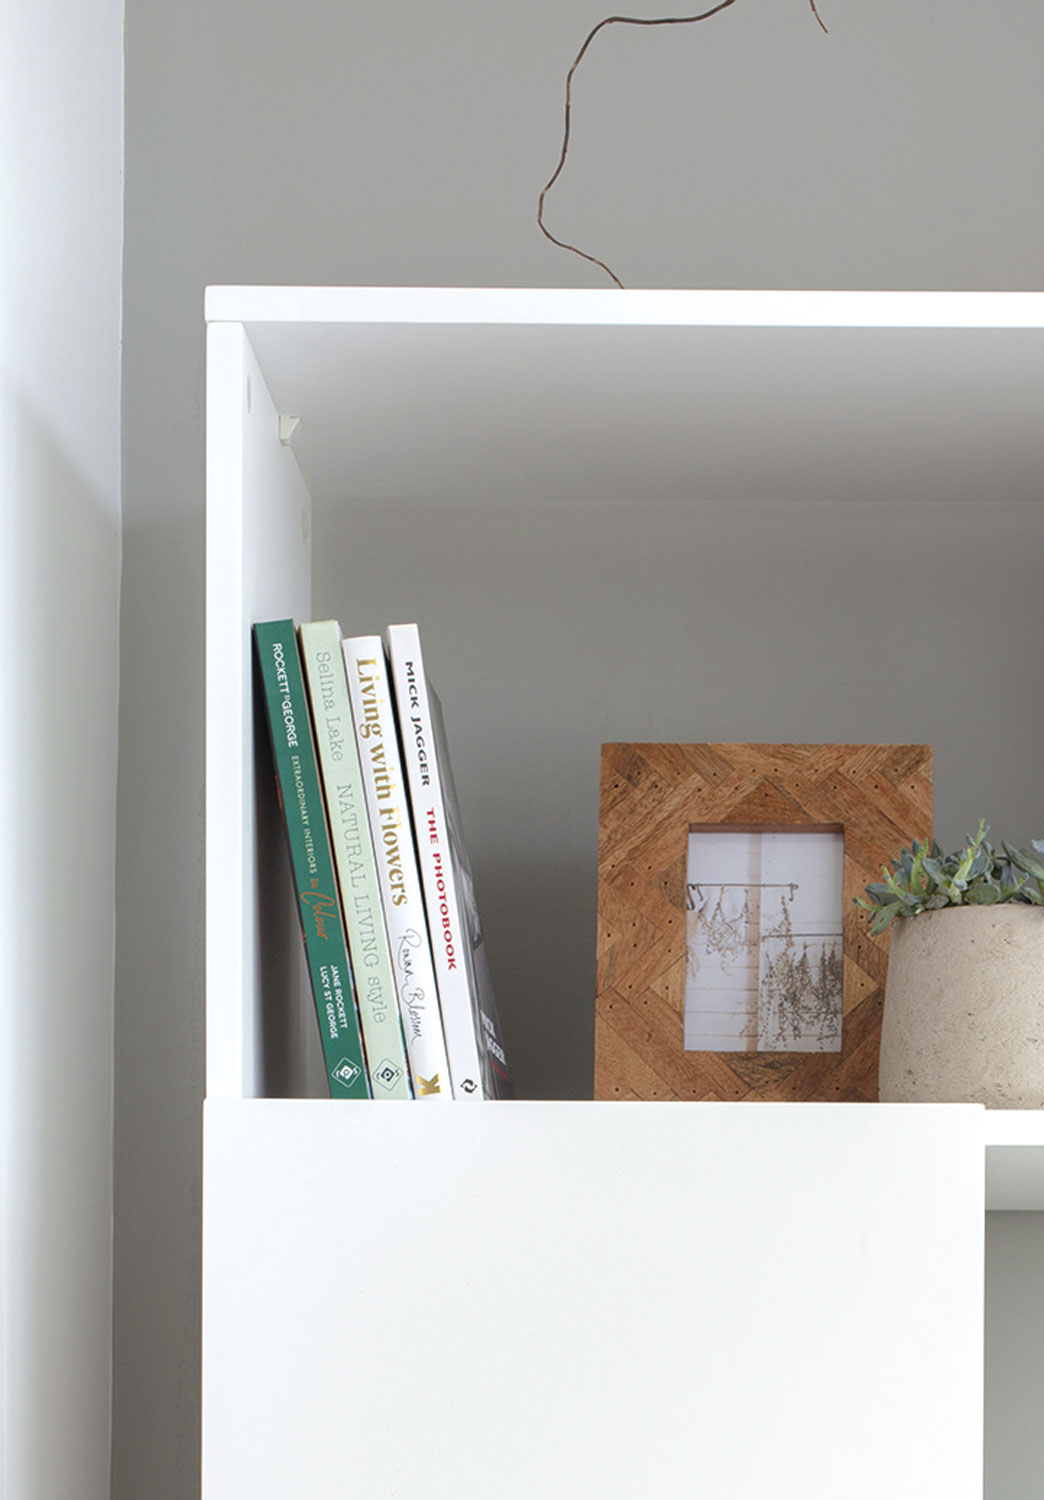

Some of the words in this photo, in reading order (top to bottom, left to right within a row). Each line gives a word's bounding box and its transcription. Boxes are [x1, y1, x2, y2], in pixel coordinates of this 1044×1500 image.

[272, 643, 290, 693] ROCKETT
[405, 661, 419, 708] MICK
[356, 657, 384, 739] Living
[281, 701, 299, 748] GEORGE
[368, 742, 397, 800] with
[411, 715, 430, 786] JAGGER
[291, 755, 309, 825] EXTRAORDINARY
[304, 826, 318, 874] INTERIORS
[316, 651, 336, 711] Selina
[326, 716, 345, 762] Lake
[336, 783, 367, 888] NATURAL
[354, 894, 380, 968] LIVING
[367, 976, 388, 1024] style
[426, 807, 439, 844] THE
[379, 806, 408, 907] Flowers
[301, 891, 336, 941] Colour
[432, 853, 457, 970] PHOTOBOOK
[319, 966, 330, 989] LUCY
[323, 990, 332, 1002] ST
[330, 964, 341, 988] JANE
[325, 1002, 339, 1039] GEORGE
[334, 988, 348, 1029] ROCKETT
